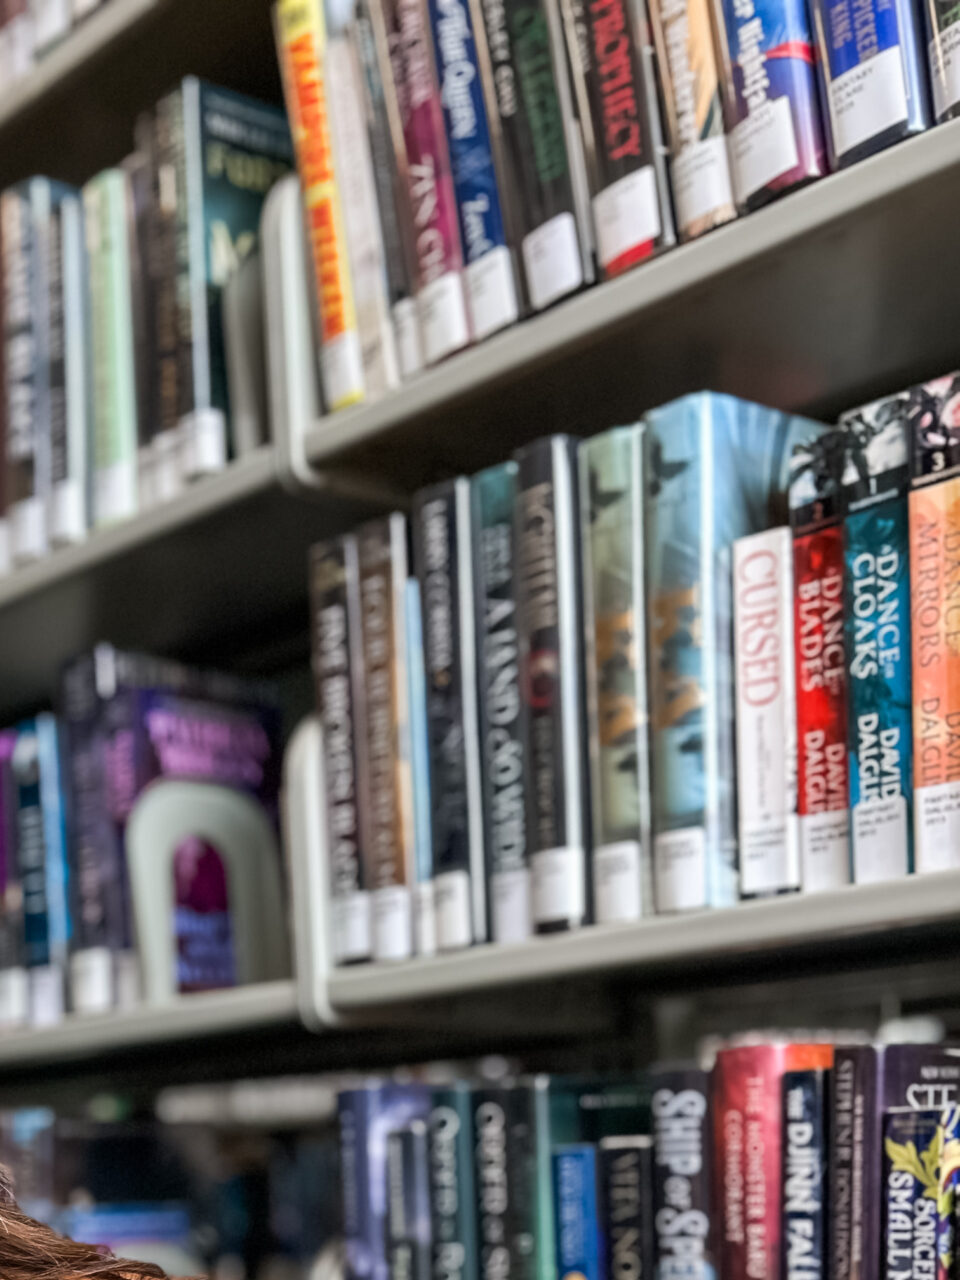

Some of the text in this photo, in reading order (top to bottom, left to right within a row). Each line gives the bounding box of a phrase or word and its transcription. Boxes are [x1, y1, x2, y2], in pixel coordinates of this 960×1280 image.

[931, 451, 946, 472] 3
[741, 549, 781, 708] CURSED
[799, 579, 825, 692] BLADES
[821, 573, 845, 683] DANCE
[849, 553, 879, 680] CLOAKS
[876, 552, 900, 669] DANCE
[914, 521, 940, 668] MIRRORS
[880, 727, 902, 800] DAVID
[651, 1087, 707, 1176] SHIP
[837, 1059, 854, 1146] STEPHEN
[723, 1108, 744, 1243] CORMORANT
[745, 1119, 767, 1220] MONSTER
[785, 1121, 823, 1214] DJINN
[746, 1223, 768, 1279] BARU
[887, 1171, 915, 1266] SMALL
